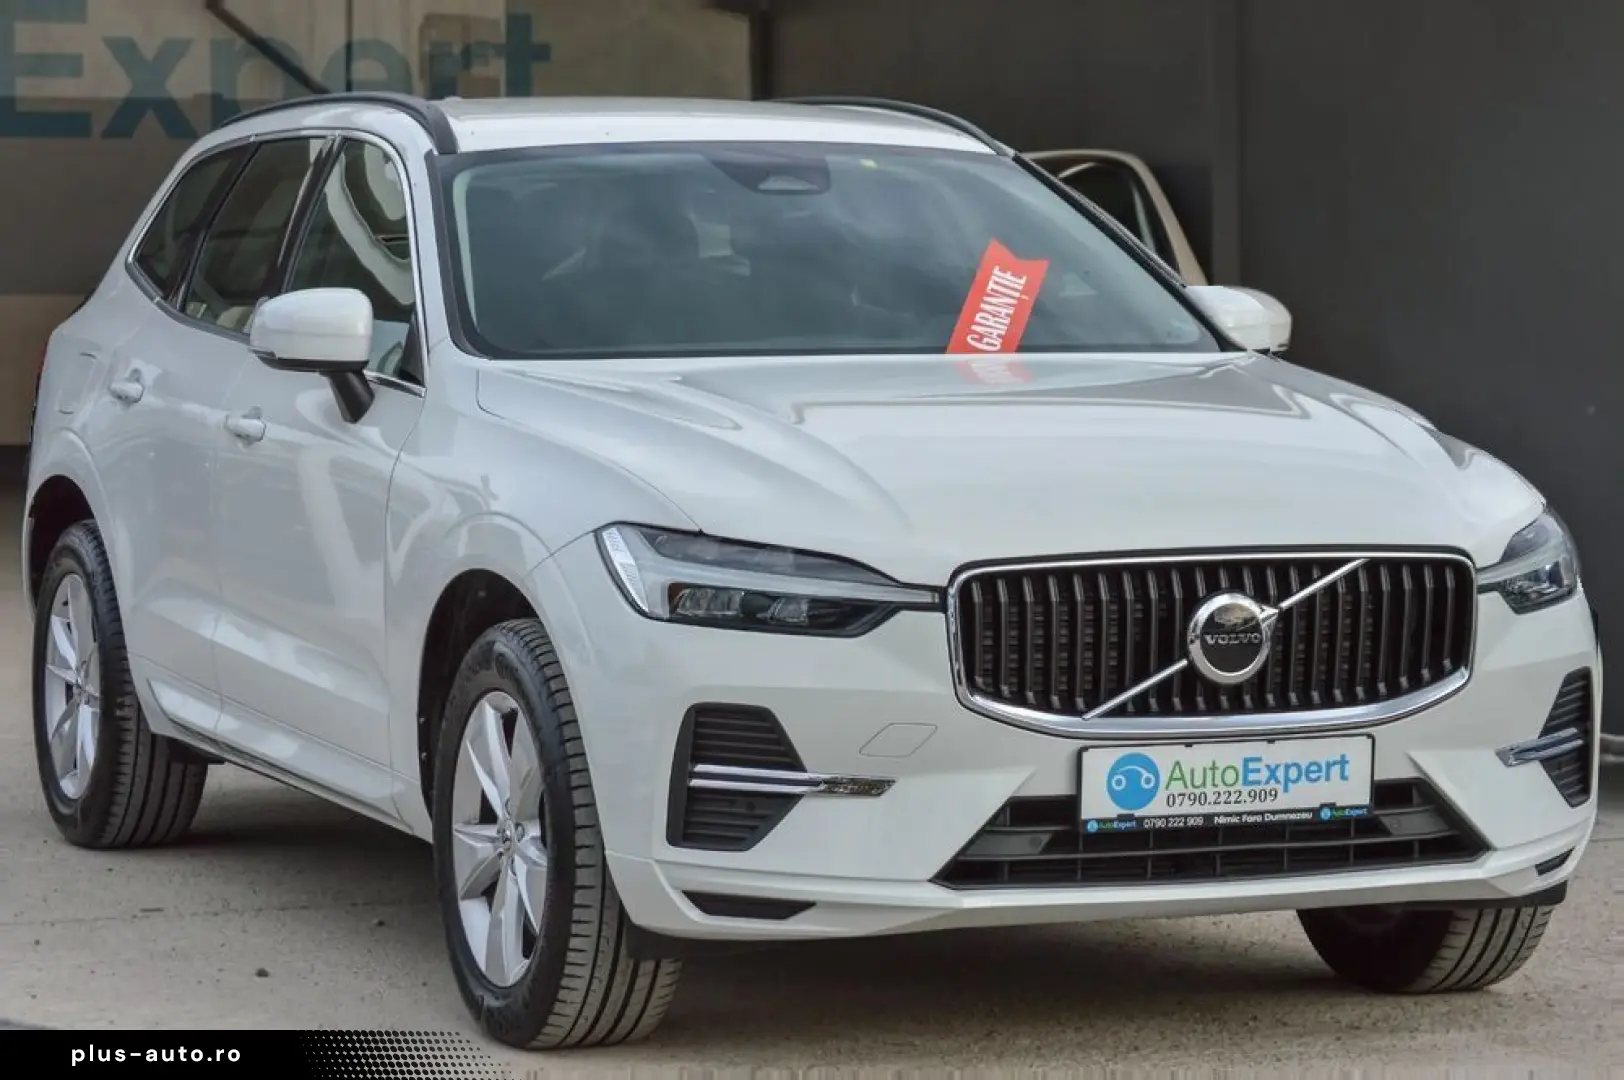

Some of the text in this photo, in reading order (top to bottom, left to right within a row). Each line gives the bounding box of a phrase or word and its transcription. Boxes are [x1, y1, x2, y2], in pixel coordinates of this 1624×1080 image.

[1203, 632, 1261, 646] VOLVO
[1165, 753, 1350, 793] AutoExpert
[1166, 787, 1279, 808] 0790.222.909
[1168, 817, 1185, 827] 222
[1214, 814, 1240, 824] Nimic
